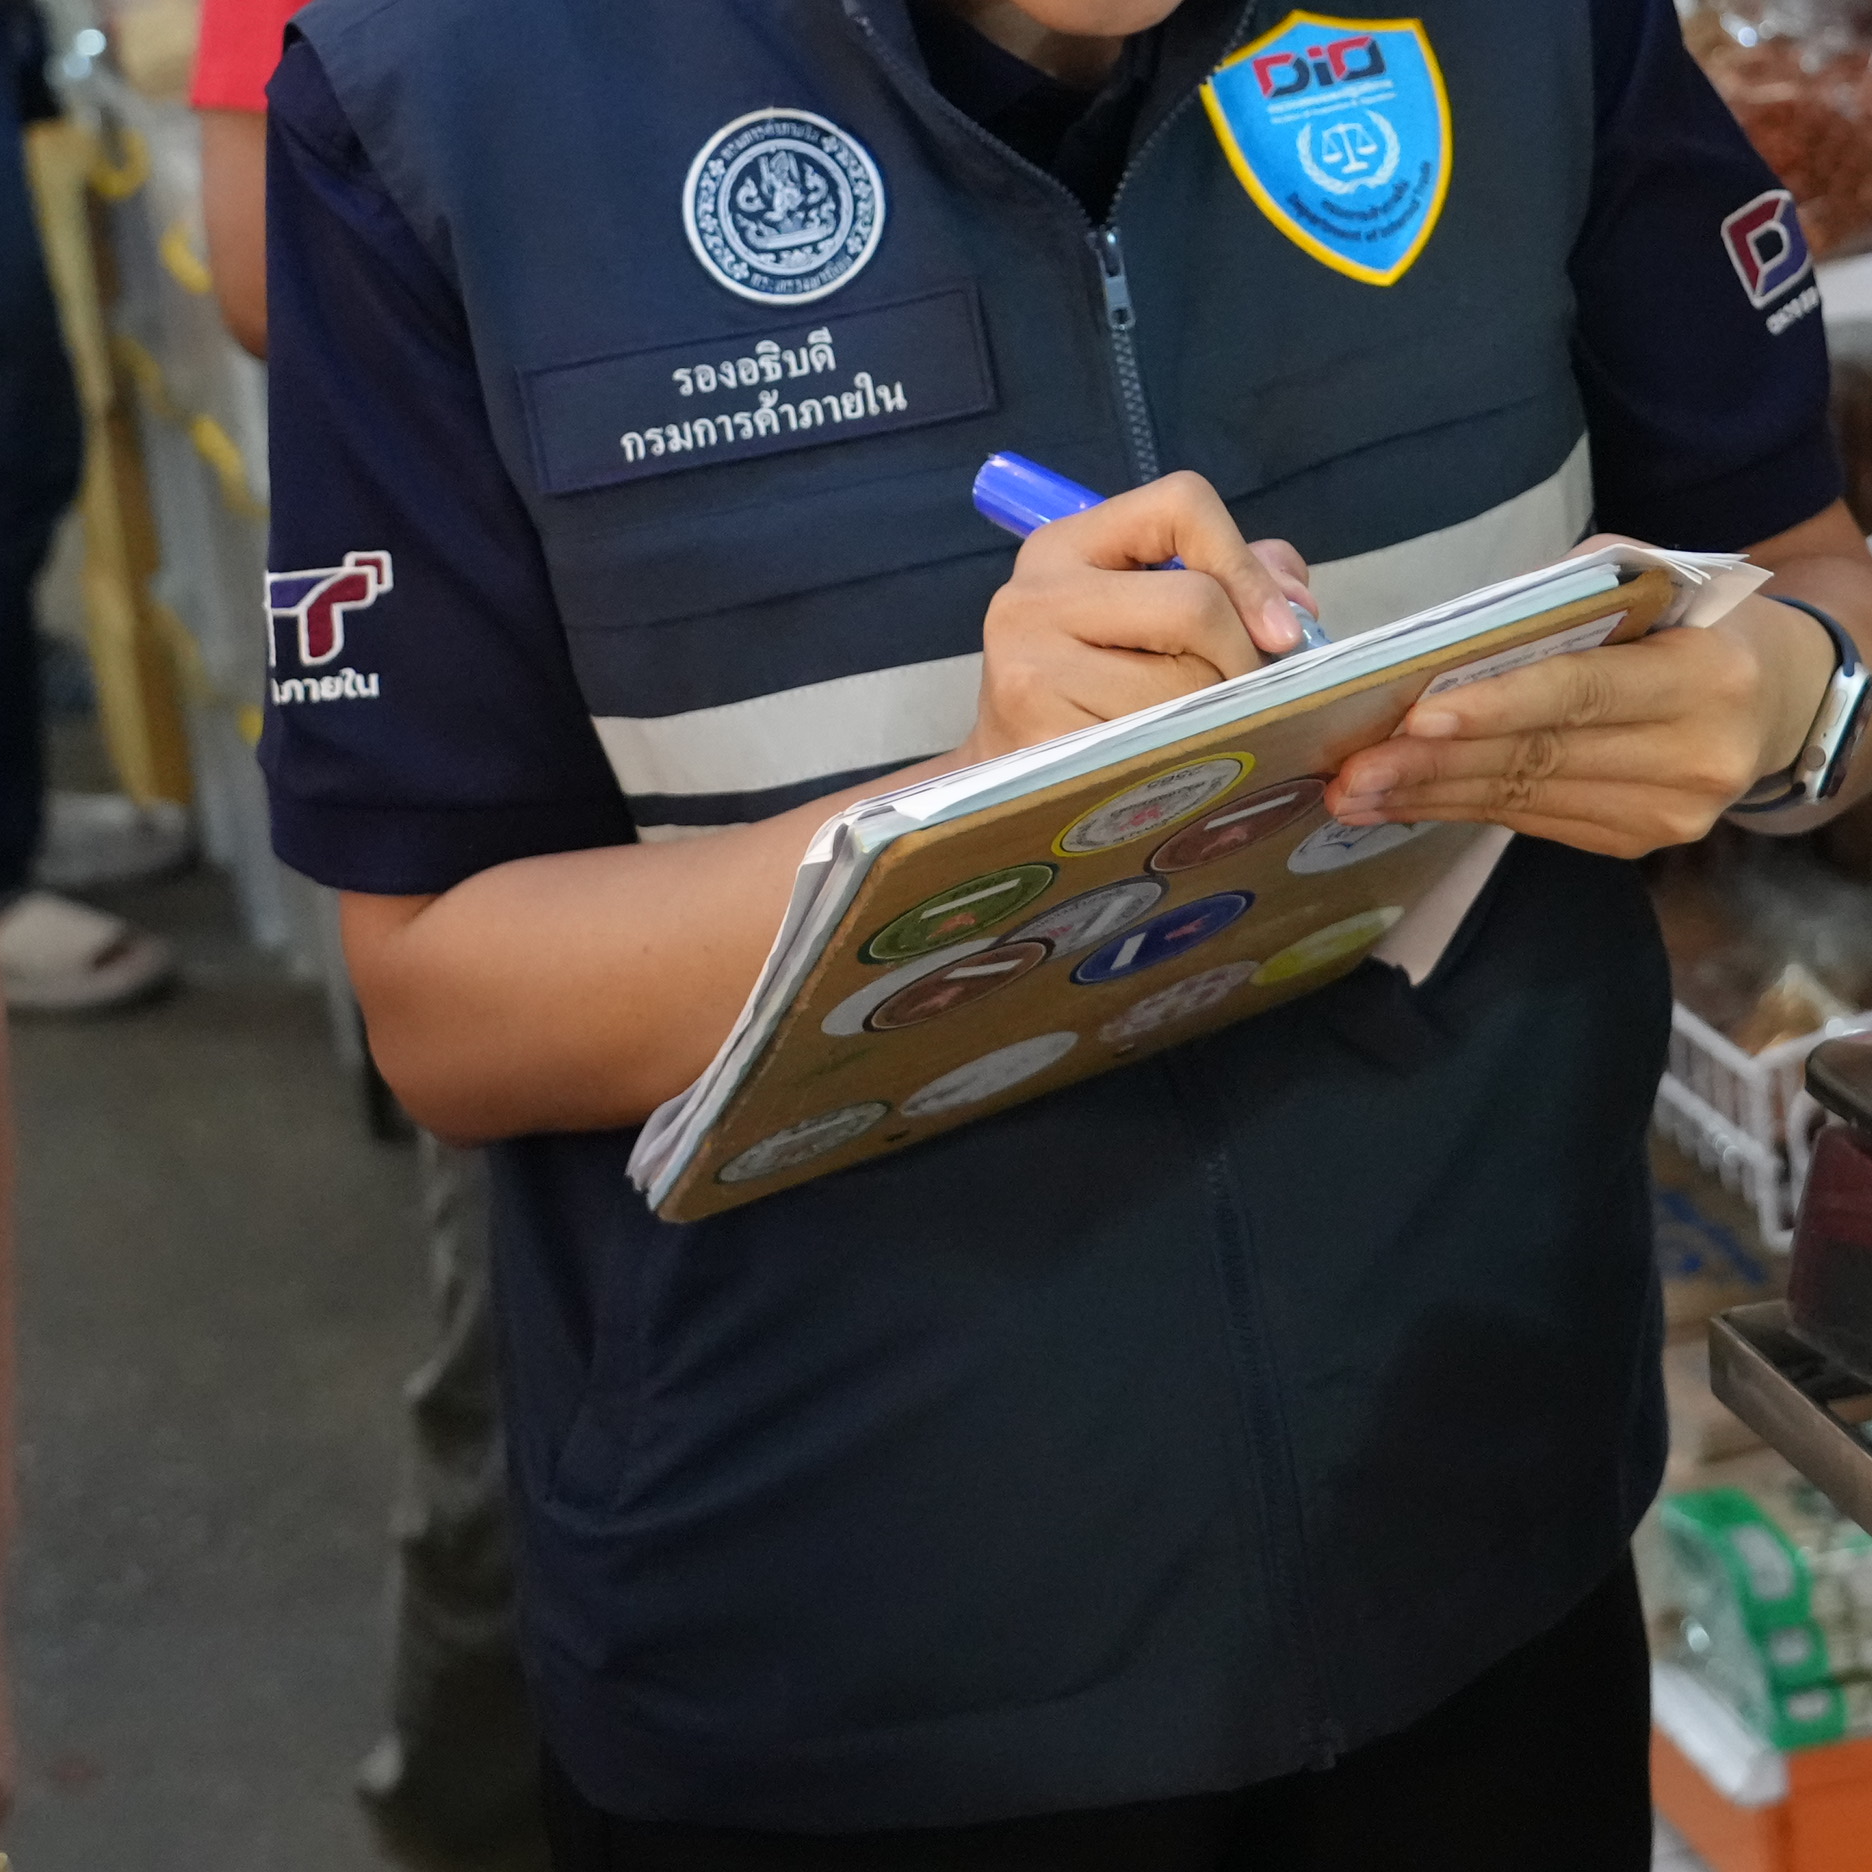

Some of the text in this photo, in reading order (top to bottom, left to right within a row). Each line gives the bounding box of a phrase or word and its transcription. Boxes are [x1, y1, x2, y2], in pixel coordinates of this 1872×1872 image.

[673, 327, 836, 396] รองอธิบดี
[620, 372, 908, 464] กรมการค้าภายใน
